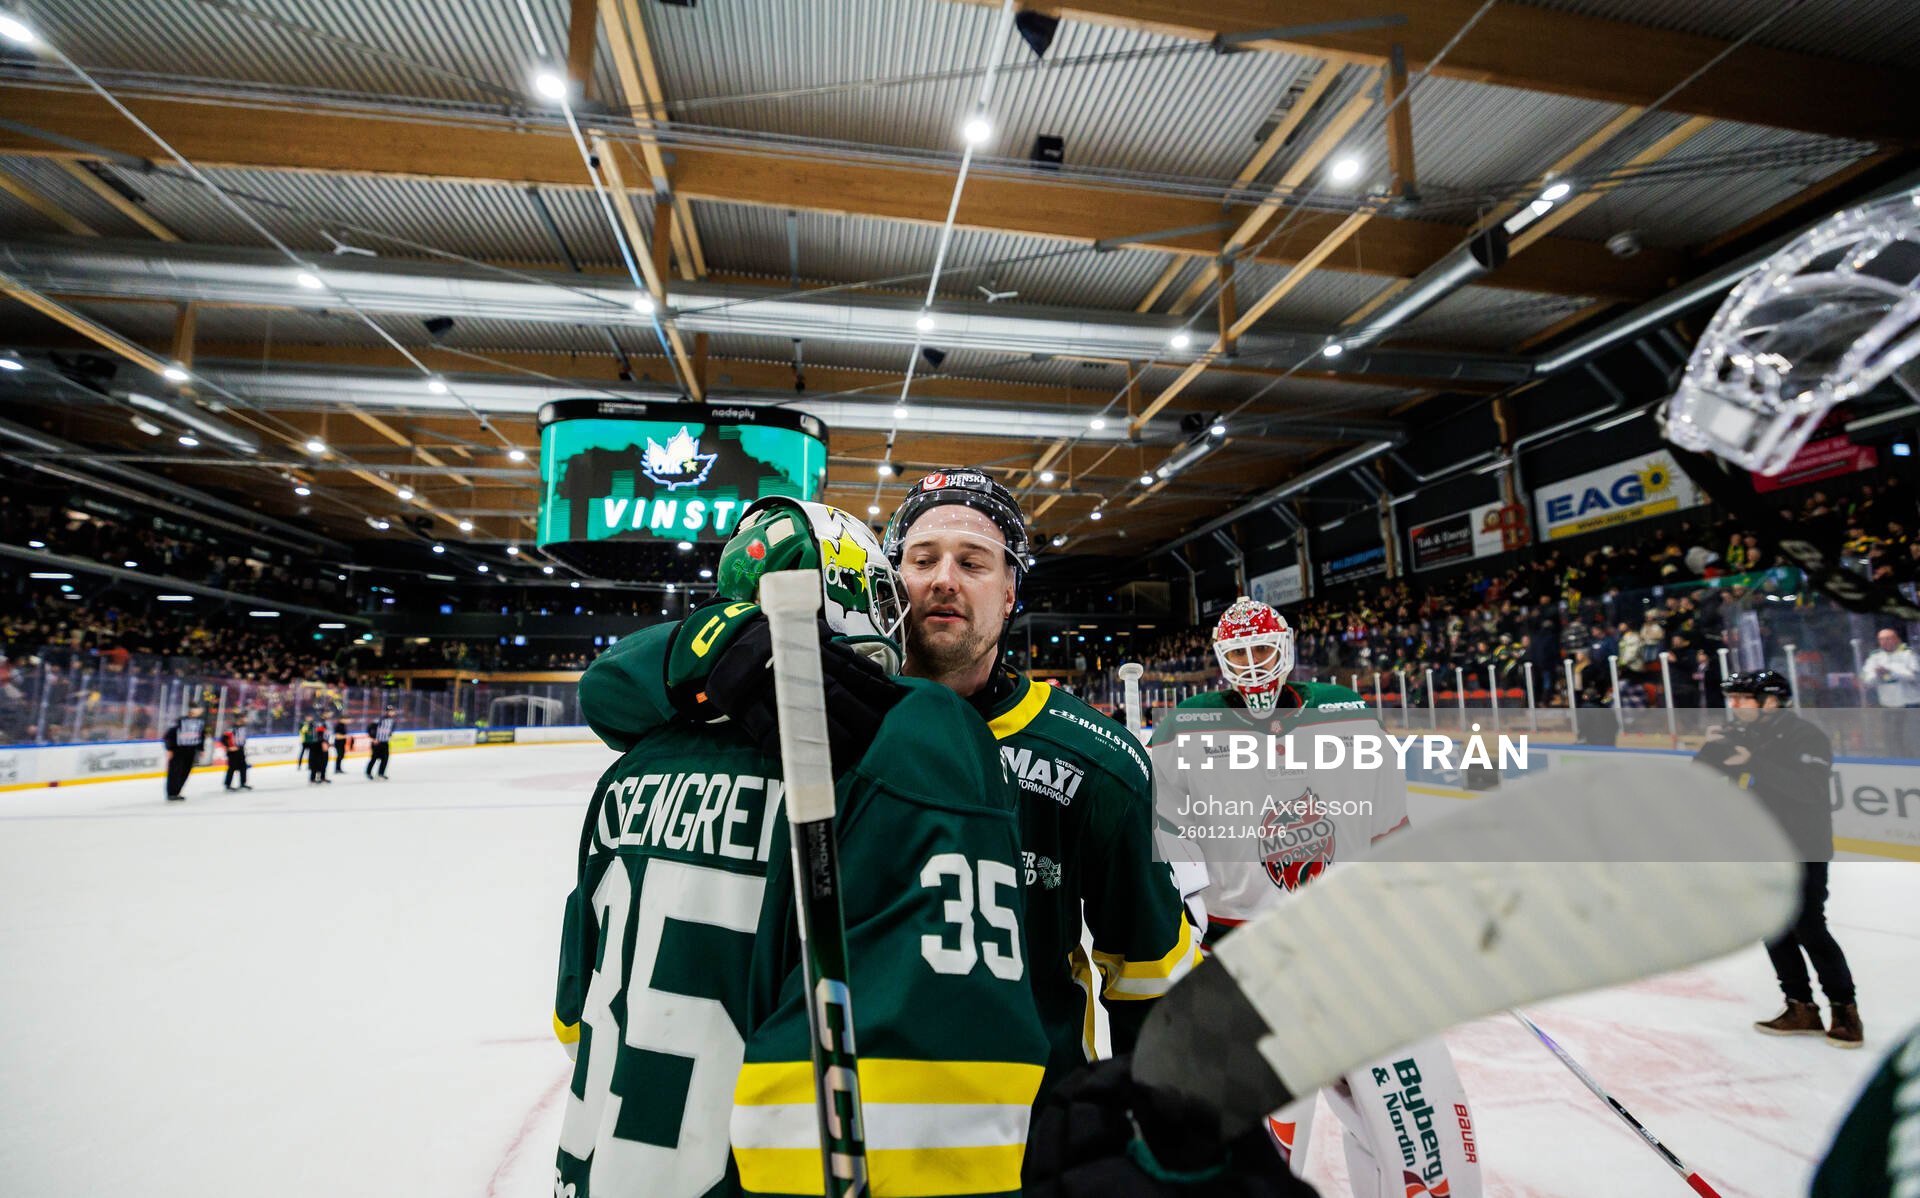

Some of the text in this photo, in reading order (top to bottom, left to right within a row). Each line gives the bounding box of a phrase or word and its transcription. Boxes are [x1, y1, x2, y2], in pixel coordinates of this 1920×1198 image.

[946, 474, 986, 484] SVENSKA
[1545, 474, 1645, 523] EAG
[603, 499, 751, 529] VINST
[1249, 693, 1275, 712] 35
[1001, 745, 1082, 799] MAXI
[1262, 822, 1330, 854] MODO
[1273, 837, 1329, 877] HOCKEY
[920, 853, 1024, 982] 35
[1371, 1067, 1416, 1168] & Nordin
[1392, 1058, 1443, 1185] Byberg
[1454, 1103, 1477, 1164] BAUER
